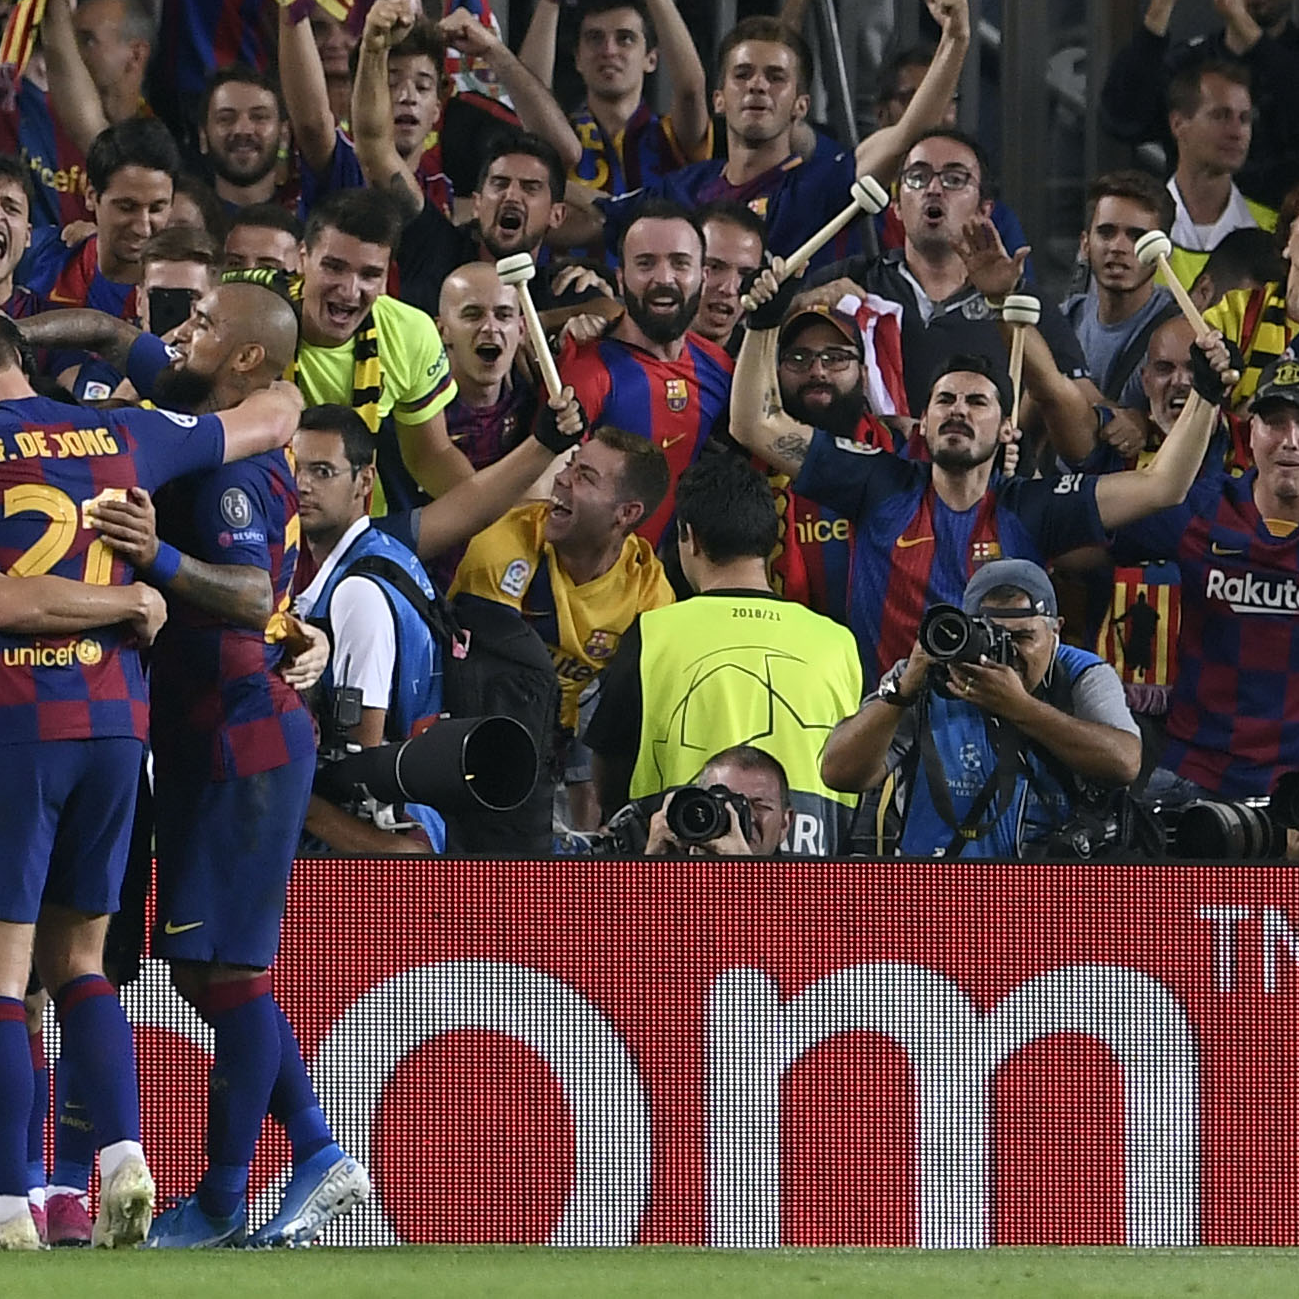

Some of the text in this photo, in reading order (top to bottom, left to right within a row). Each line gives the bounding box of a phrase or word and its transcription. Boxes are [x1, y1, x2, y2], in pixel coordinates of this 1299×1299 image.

[14, 430, 52, 459] DE
[50, 427, 119, 459] JONG
[4, 482, 128, 587] 21
[795, 514, 849, 544] nice
[731, 607, 782, 623] 2018/21
[3, 641, 77, 667] unicef
